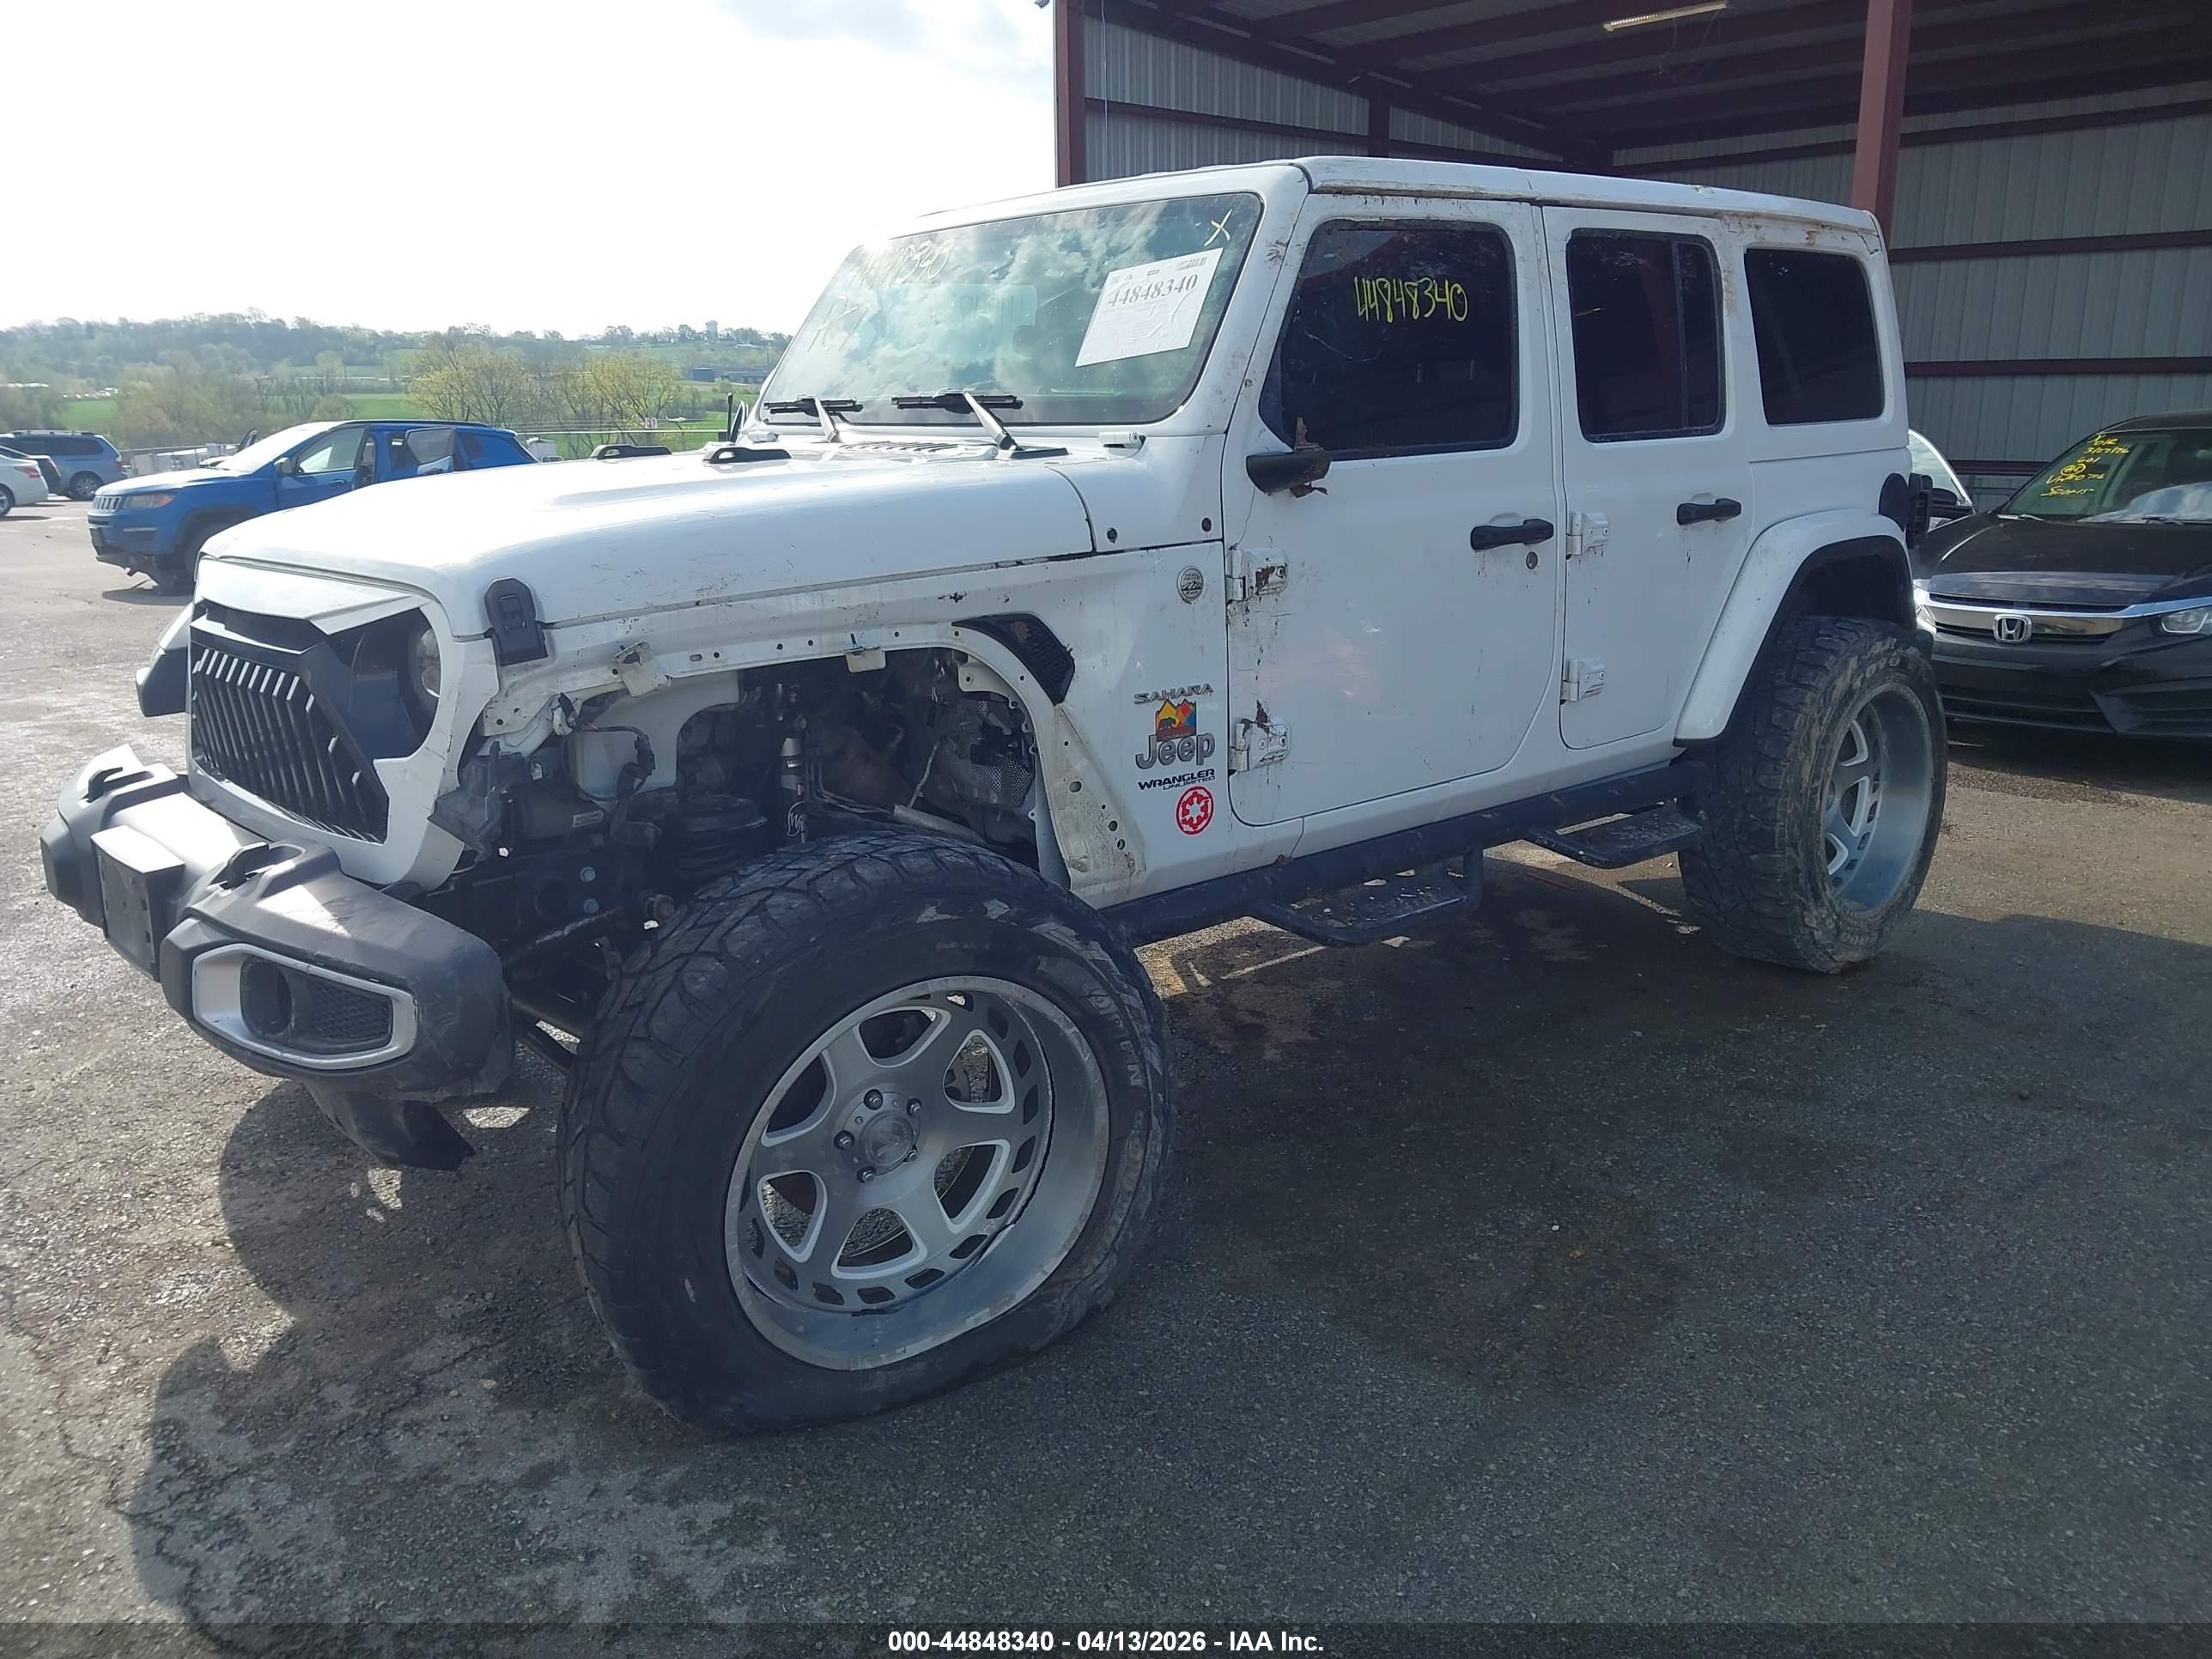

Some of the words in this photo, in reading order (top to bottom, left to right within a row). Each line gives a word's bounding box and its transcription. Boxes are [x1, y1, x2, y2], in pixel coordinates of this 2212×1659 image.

[1108, 274, 1198, 307] 44848340
[1354, 276, 1468, 323] 44848340
[1134, 683, 1214, 704] SAHARA
[1135, 732, 1215, 769] Jeep
[1137, 769, 1215, 790] WRANGLER
[1163, 775, 1215, 790] UNLIMITED
